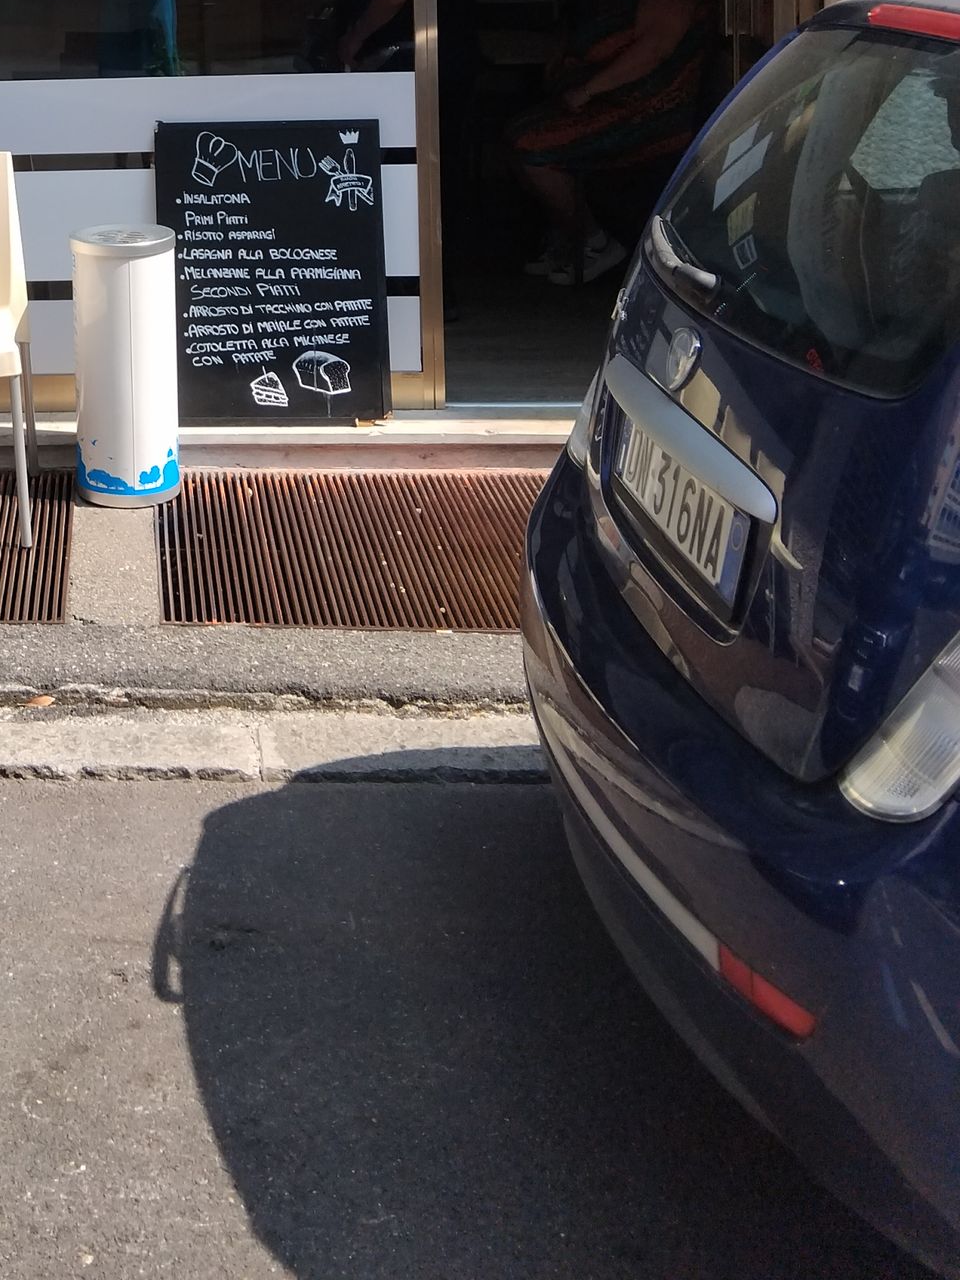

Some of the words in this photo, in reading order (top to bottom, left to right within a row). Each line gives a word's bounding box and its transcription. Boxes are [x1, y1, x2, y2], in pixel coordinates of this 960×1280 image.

[237, 147, 317, 182] MENU
[183, 191, 251, 205] INSALATONA
[185, 211, 214, 226] PRIMI
[184, 230, 224, 241] RISOTTO
[228, 228, 276, 240] ASPARAGI
[183, 248, 232, 260] LASAGNA
[239, 249, 264, 260] ALLA
[269, 248, 338, 260] BOLOGNESE
[184, 266, 250, 280] MELANZANE
[255, 268, 285, 279] ALLA
[290, 266, 361, 279] PARMIGIANA
[190, 284, 252, 300] SECONDI
[256, 282, 301, 297] PIATTI
[189, 305, 239, 318] ARROSTO
[240, 302, 253, 315] DI
[255, 302, 312, 314] TACCHINO
[314, 301, 334, 311] CON
[334, 299, 373, 312] PATATE
[188, 324, 239, 338] ARROSTO
[242, 322, 253, 334] DI
[257, 319, 302, 333] MAIALE
[304, 318, 326, 328] CON
[330, 315, 371, 327] PATATE
[190, 339, 258, 354] COTOLETTA
[261, 337, 289, 349] ALLA
[294, 333, 350, 346] MILANESE
[192, 355, 224, 367] CON
[232, 350, 276, 364] PATATE
